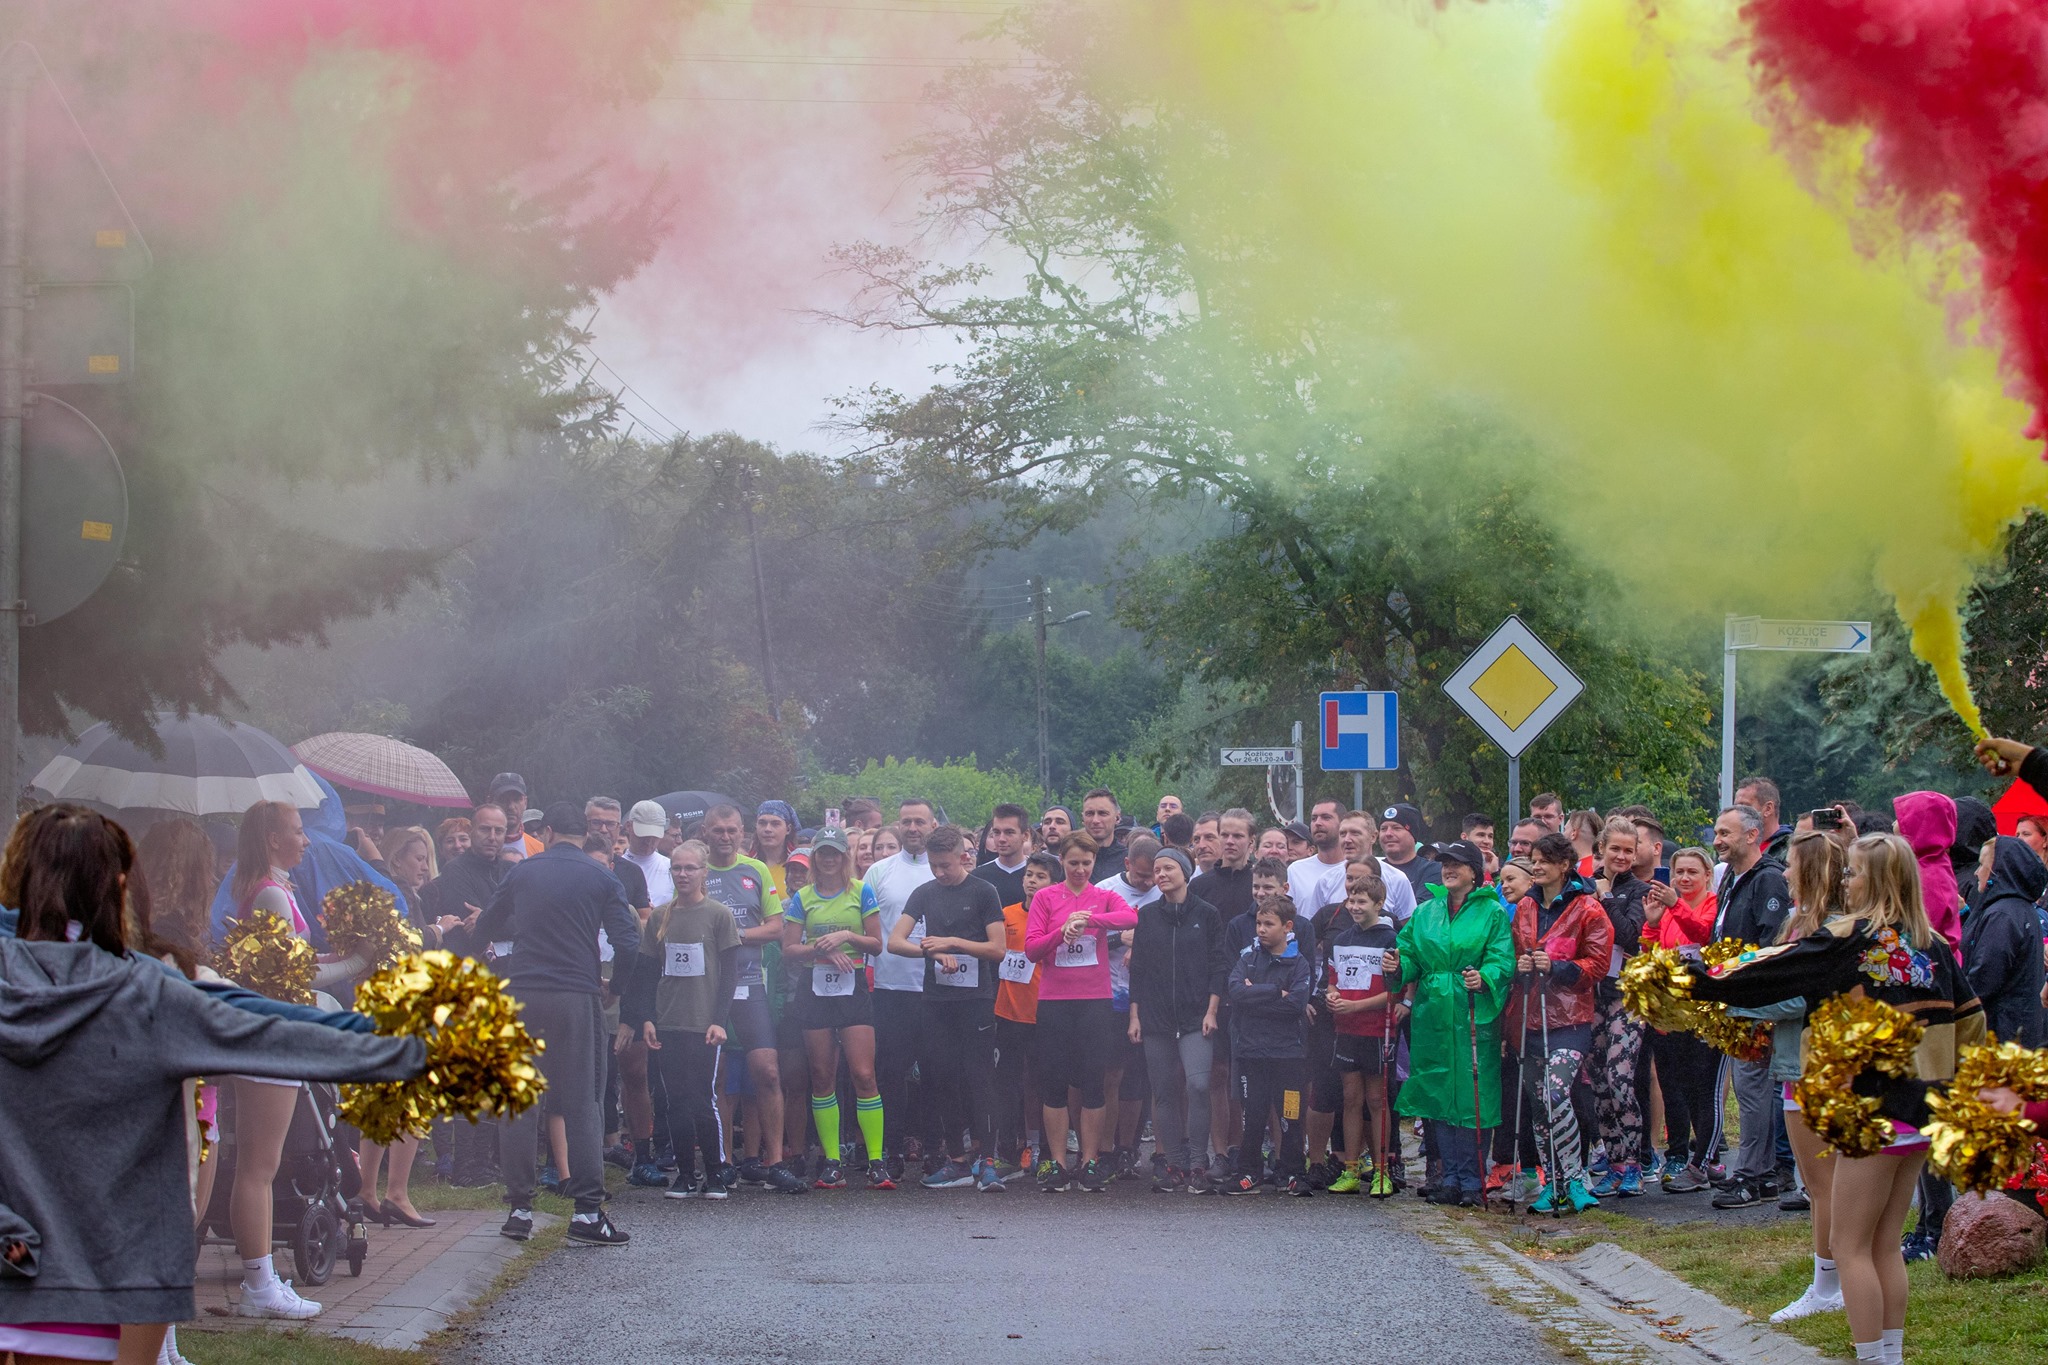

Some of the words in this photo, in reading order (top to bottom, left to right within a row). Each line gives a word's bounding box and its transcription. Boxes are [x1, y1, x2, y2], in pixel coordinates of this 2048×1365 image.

[683, 810, 704, 818] KGHM
[705, 878, 722, 886] GHM
[1068, 944, 1084, 954] 80
[675, 953, 690, 963] 23
[960, 963, 968, 973] 0
[1008, 958, 1026, 969] 113
[1345, 967, 1358, 976] 57
[825, 974, 840, 983] 87
